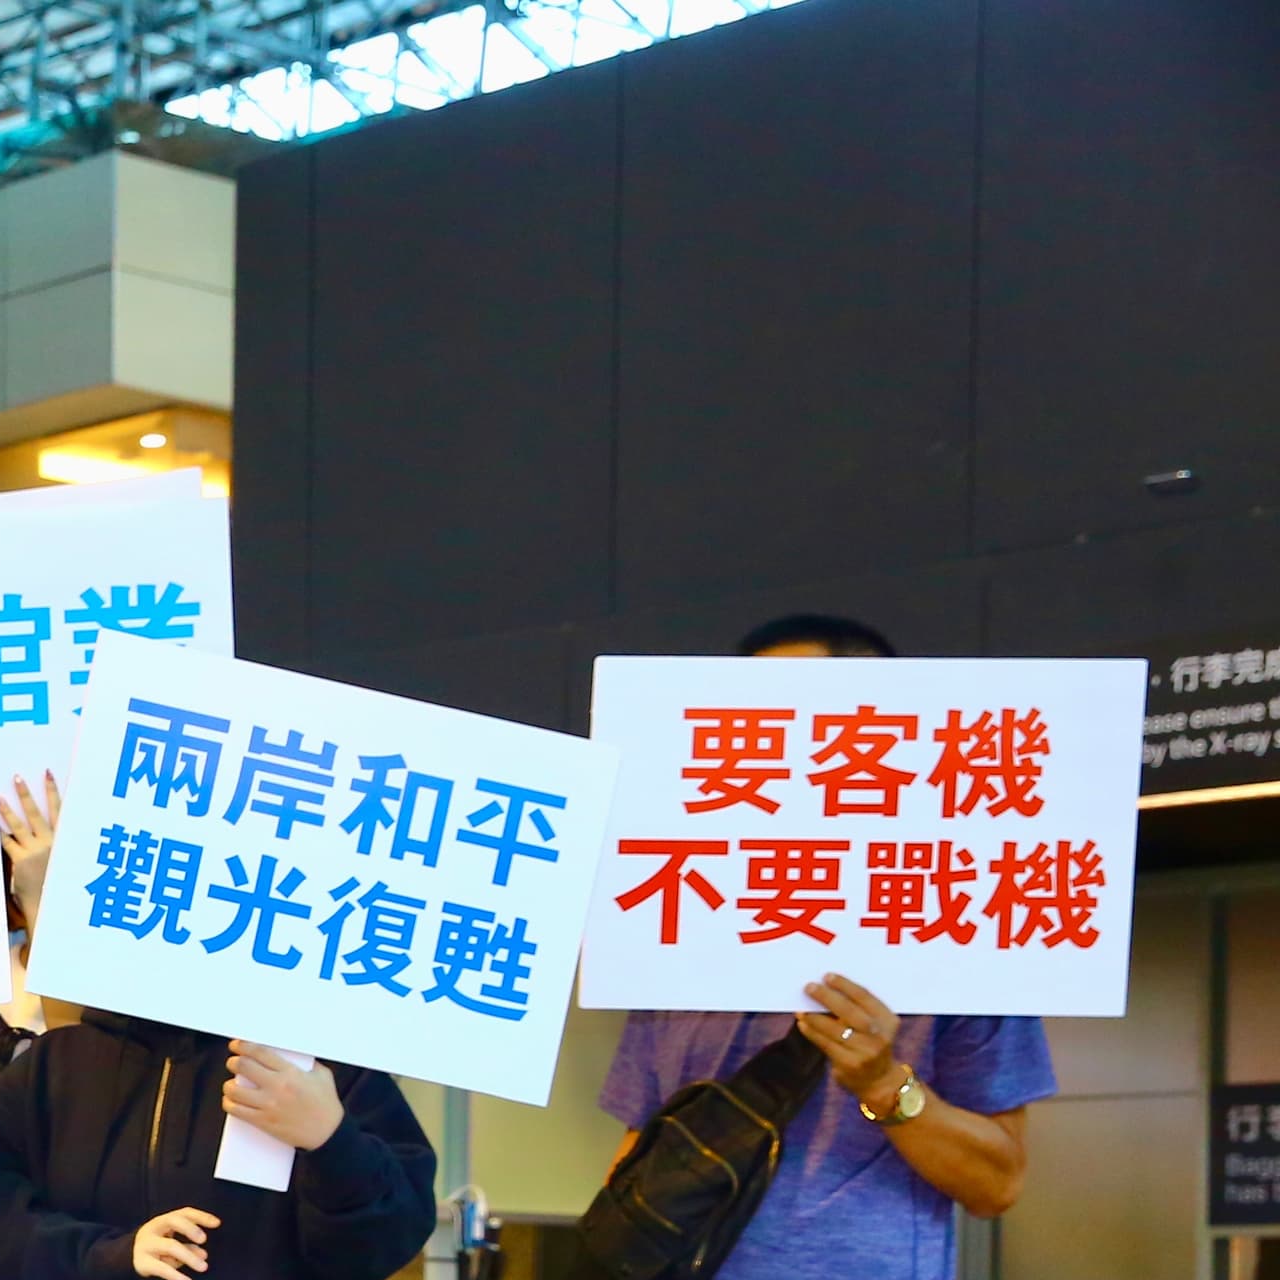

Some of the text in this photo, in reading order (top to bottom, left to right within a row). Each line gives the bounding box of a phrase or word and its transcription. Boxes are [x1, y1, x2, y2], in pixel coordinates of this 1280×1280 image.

[112, 697, 567, 887] 兩岸和平
[681, 705, 1049, 818] 要客機
[85, 824, 537, 1021] 觀光復甦
[615, 839, 1104, 949] 不要戰機
